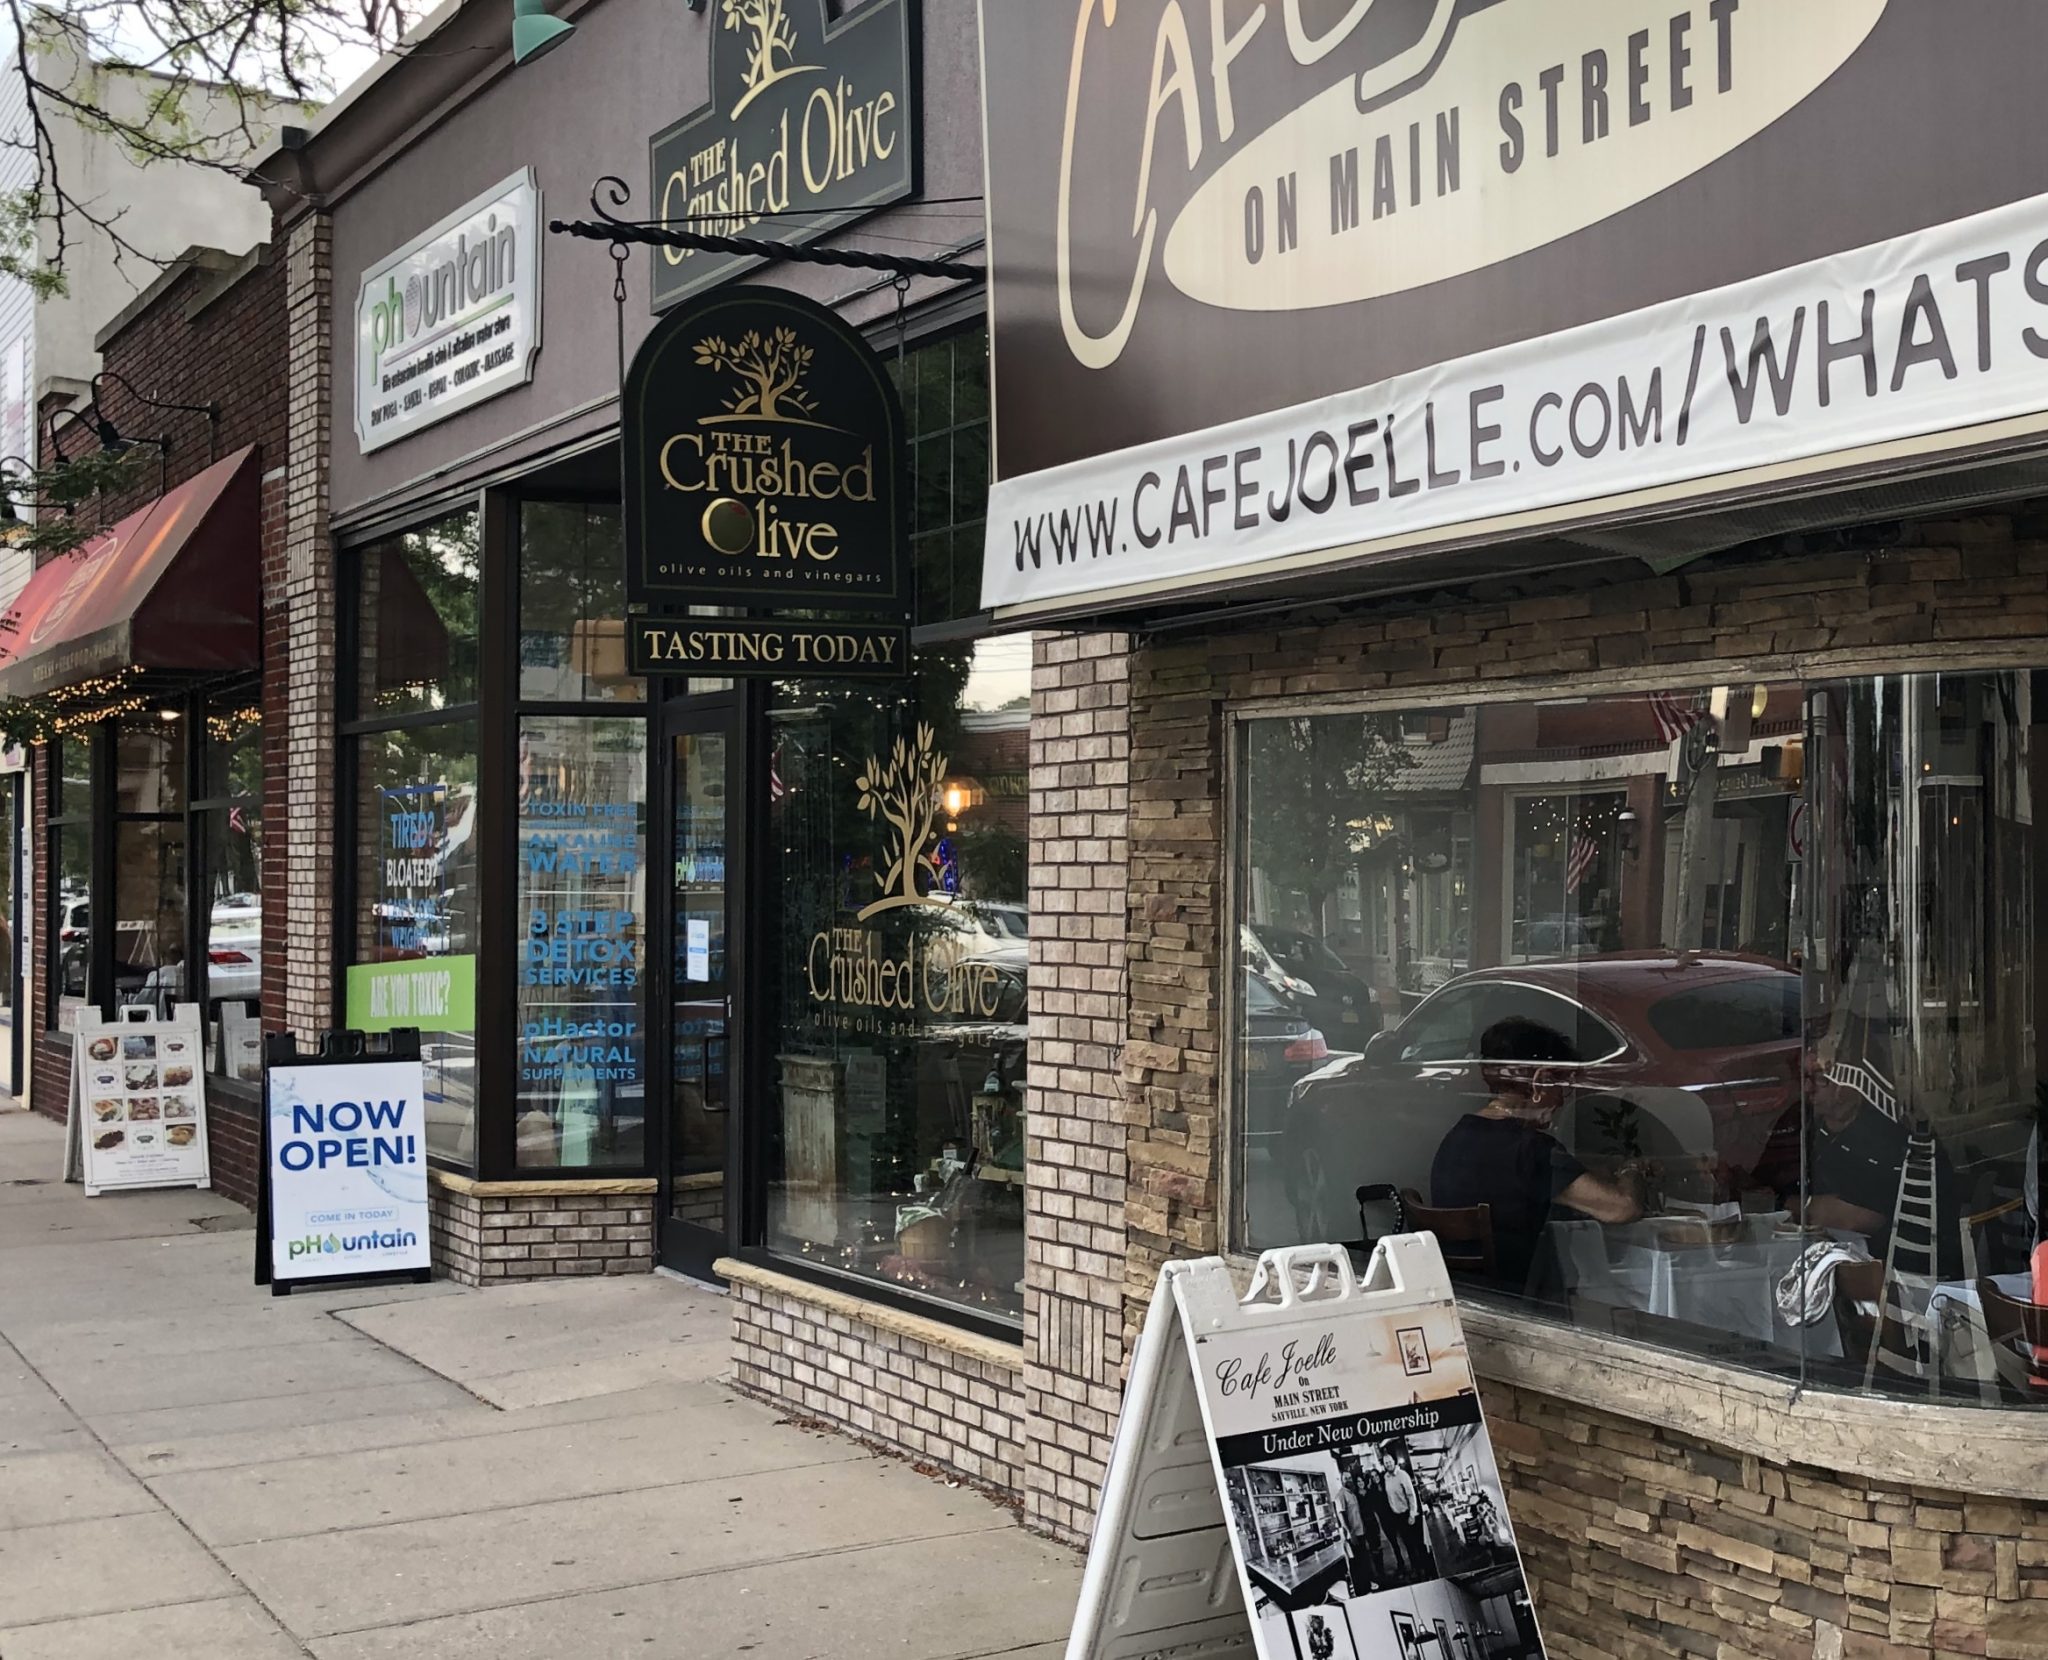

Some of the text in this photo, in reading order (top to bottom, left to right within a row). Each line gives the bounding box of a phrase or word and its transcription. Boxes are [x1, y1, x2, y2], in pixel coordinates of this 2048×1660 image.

[1244, 171, 1297, 265] ON
[1329, 106, 1460, 236] MAIN
[1499, 0, 1740, 174] STREET
[661, 75, 896, 265] Crushed Olive
[690, 138, 726, 187] THE
[711, 431, 772, 455] THE
[660, 432, 876, 501] Crushed
[701, 497, 839, 561] Olive
[659, 563, 881, 584] olive oils and vinegars
[644, 631, 896, 664] TASTING TODAY
[528, 802, 637, 817] TOXIN FREE
[391, 810, 436, 849] TIRED?
[386, 858, 438, 888] BLOATED?
[527, 849, 638, 875] WATER
[530, 910, 636, 934] 3 STEP
[527, 939, 636, 963] DETOX
[833, 928, 862, 952] THE
[526, 967, 636, 985] SERVICES
[809, 930, 999, 1017] Crushed Olive
[371, 970, 450, 1018] ARE YOU TOXIC?
[524, 1017, 636, 1044] pHactor
[815, 1010, 848, 1029] olive
[857, 1016, 882, 1034] oils
[891, 1020, 916, 1037] and
[524, 1046, 636, 1063] NATURAL
[522, 1068, 636, 1081] SUPPENTS
[292, 1100, 406, 1134] NOW
[280, 1135, 416, 1171] OPEN!
[310, 1210, 393, 1223] COME IN TODAY
[1216, 1332, 1336, 1399] Cafe Joelle
[1299, 1375, 1310, 1387] On
[1273, 1386, 1340, 1409] MAIN STREET
[1310, 1405, 1327, 1416] NEW
[1329, 1400, 1349, 1413] YORK
[1262, 1407, 1440, 1455] Under New Ownership
